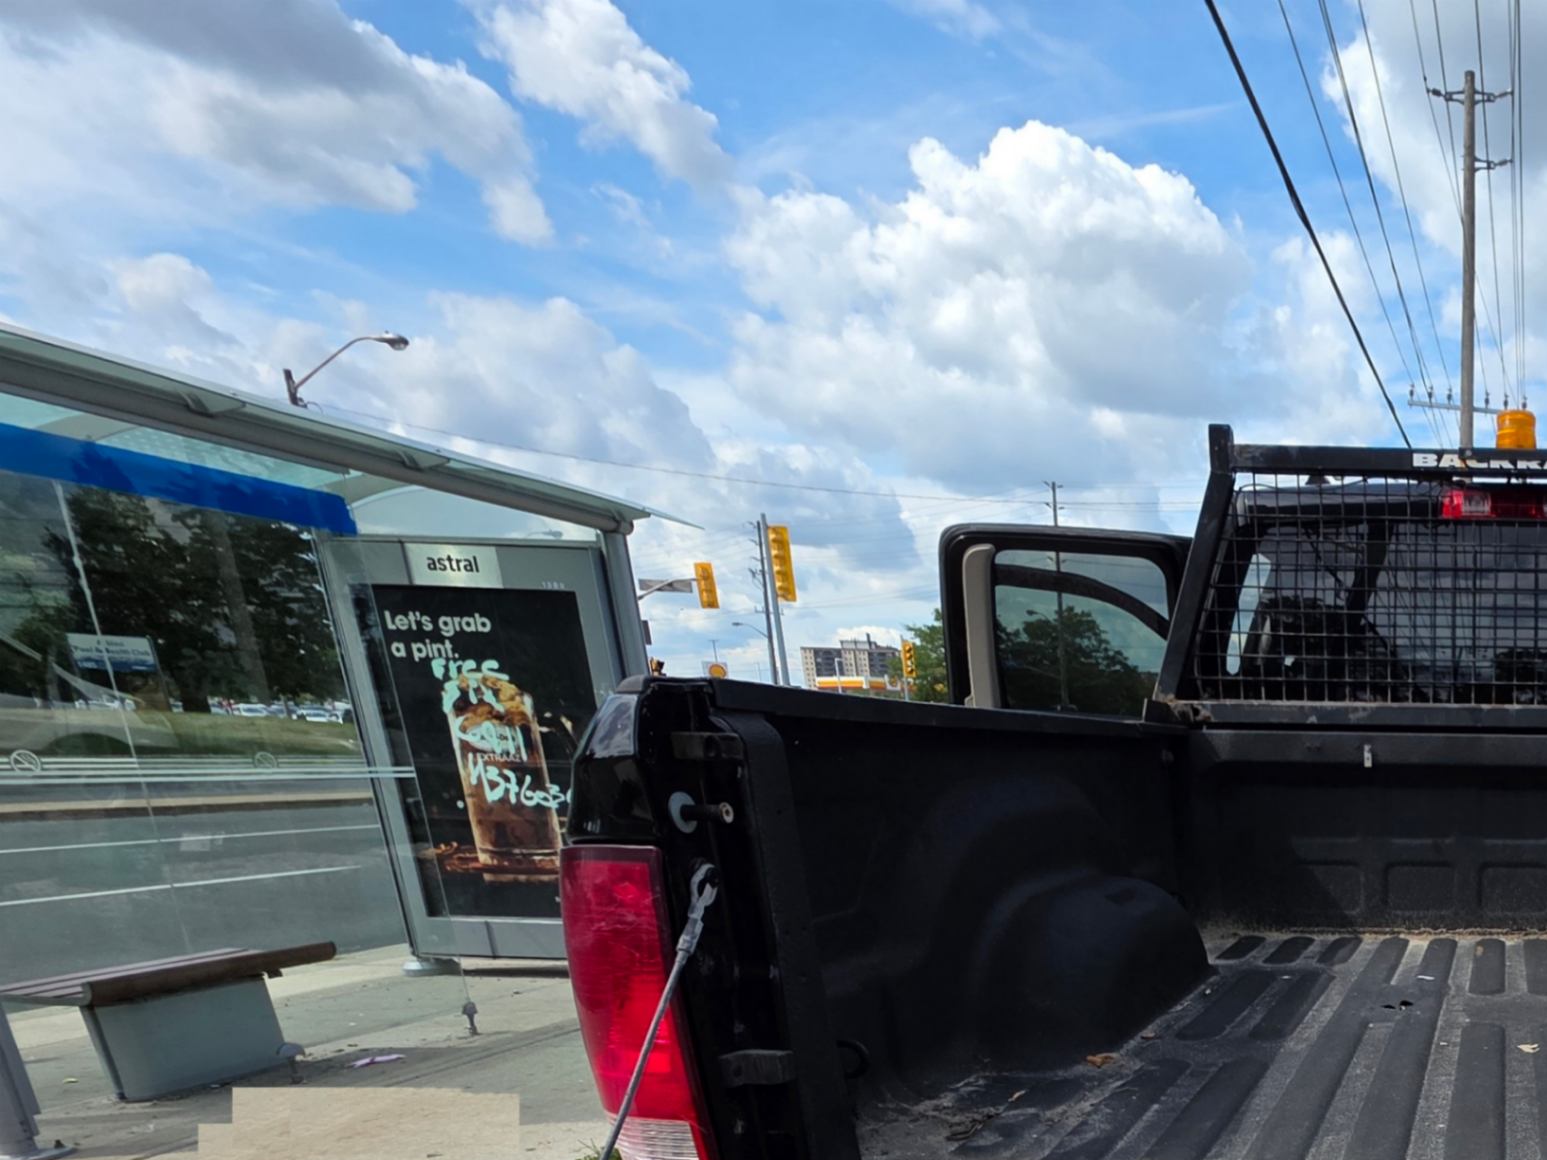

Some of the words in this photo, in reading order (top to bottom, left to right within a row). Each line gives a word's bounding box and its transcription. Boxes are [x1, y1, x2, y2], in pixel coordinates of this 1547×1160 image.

[427, 554, 480, 573] astral
[384, 610, 433, 631] Let's
[438, 613, 492, 637] grab
[391, 641, 406, 658] a
[411, 639, 459, 661] pint.
